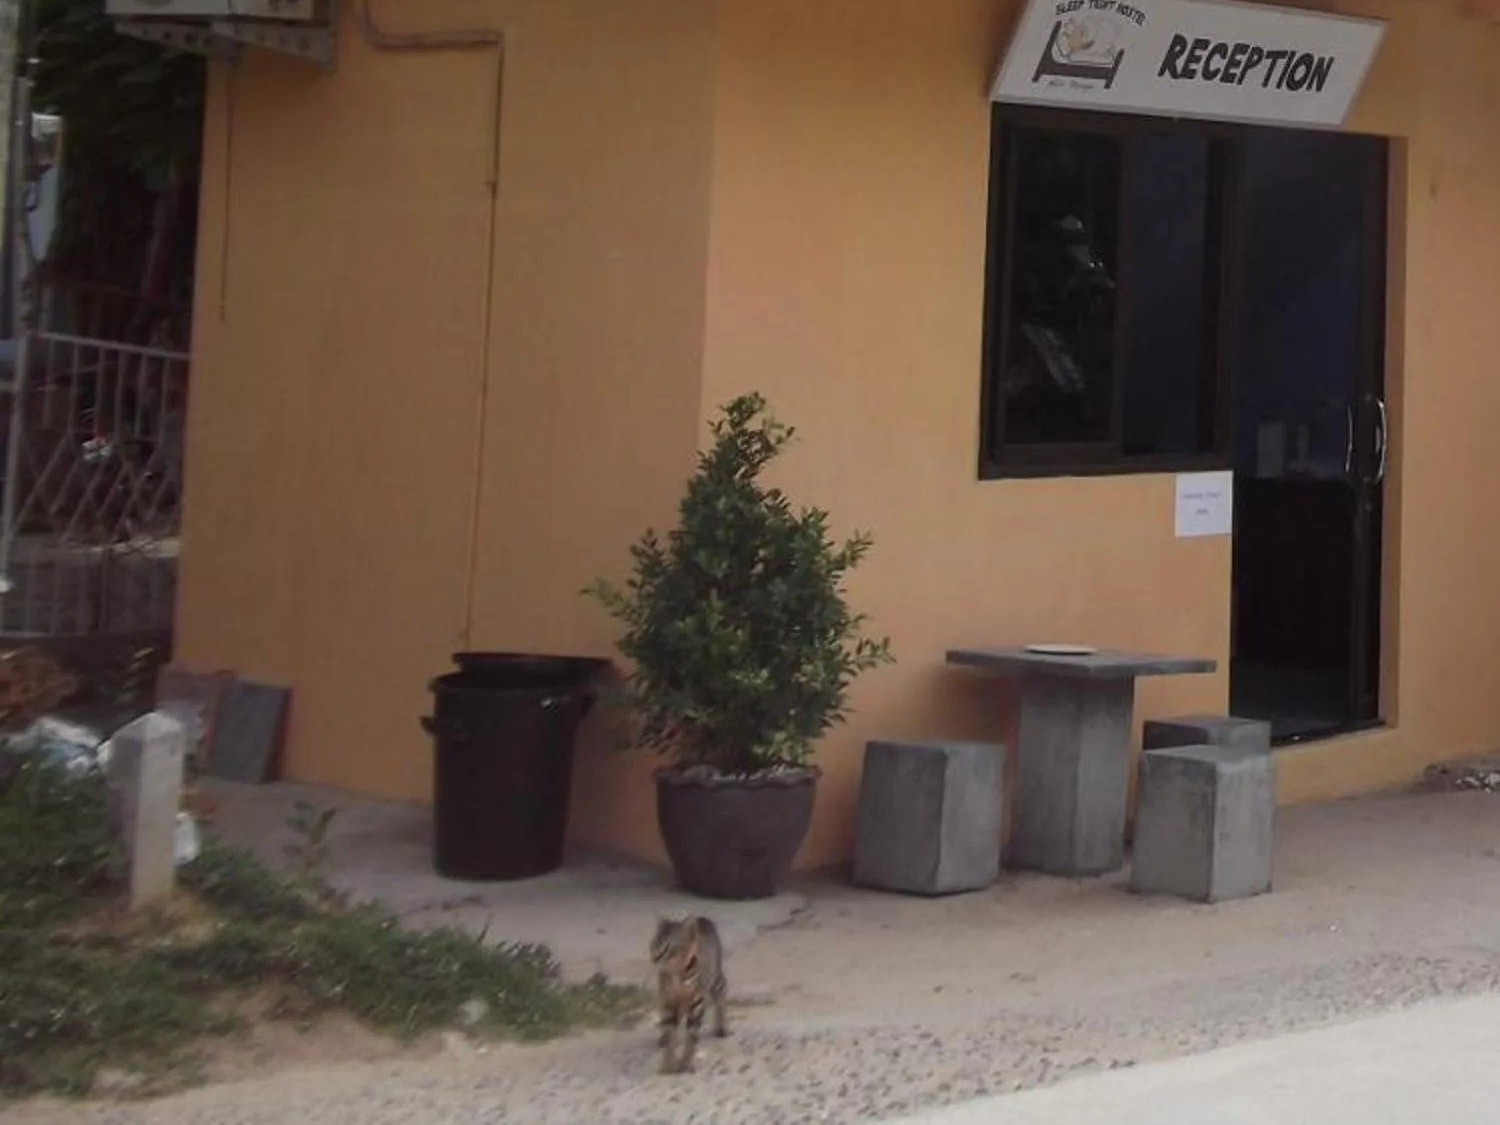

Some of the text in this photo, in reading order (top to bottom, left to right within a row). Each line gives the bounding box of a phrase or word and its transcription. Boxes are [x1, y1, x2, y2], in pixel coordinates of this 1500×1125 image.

[1055, 0, 1085, 16] SLEEP
[1116, 1, 1147, 27] HOSTEL
[1157, 32, 1336, 93] RECEPTION
